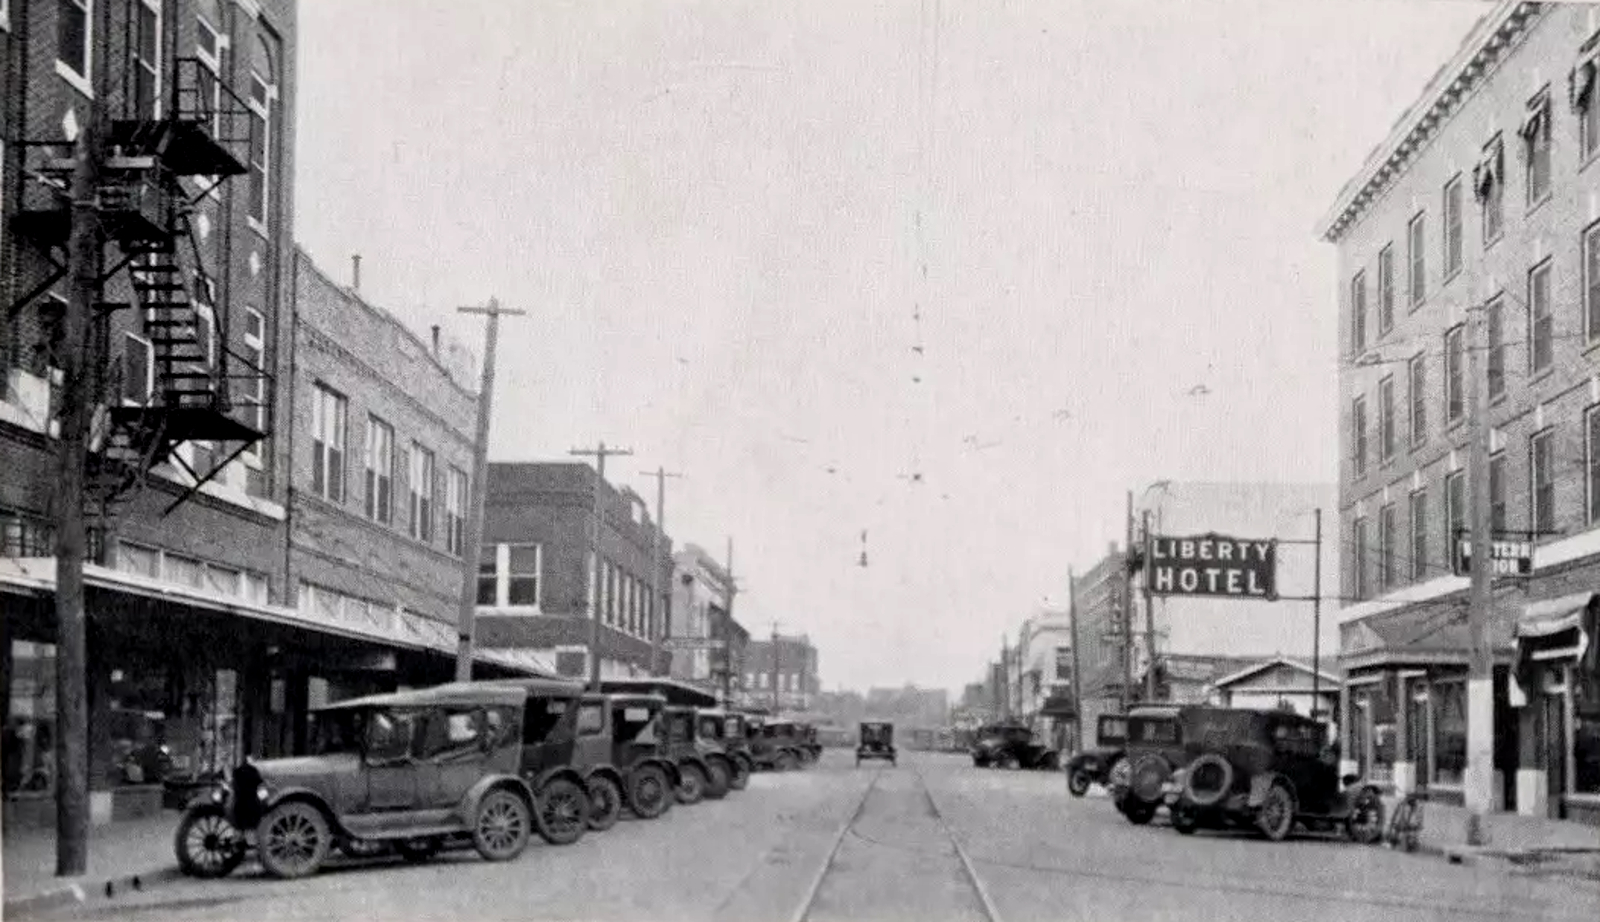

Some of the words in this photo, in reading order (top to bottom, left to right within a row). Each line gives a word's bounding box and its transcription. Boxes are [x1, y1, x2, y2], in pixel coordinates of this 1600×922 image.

[1152, 539, 1270, 561] LIBERTY
[1479, 559, 1518, 573] ION
[1155, 566, 1265, 594] HOTEL
